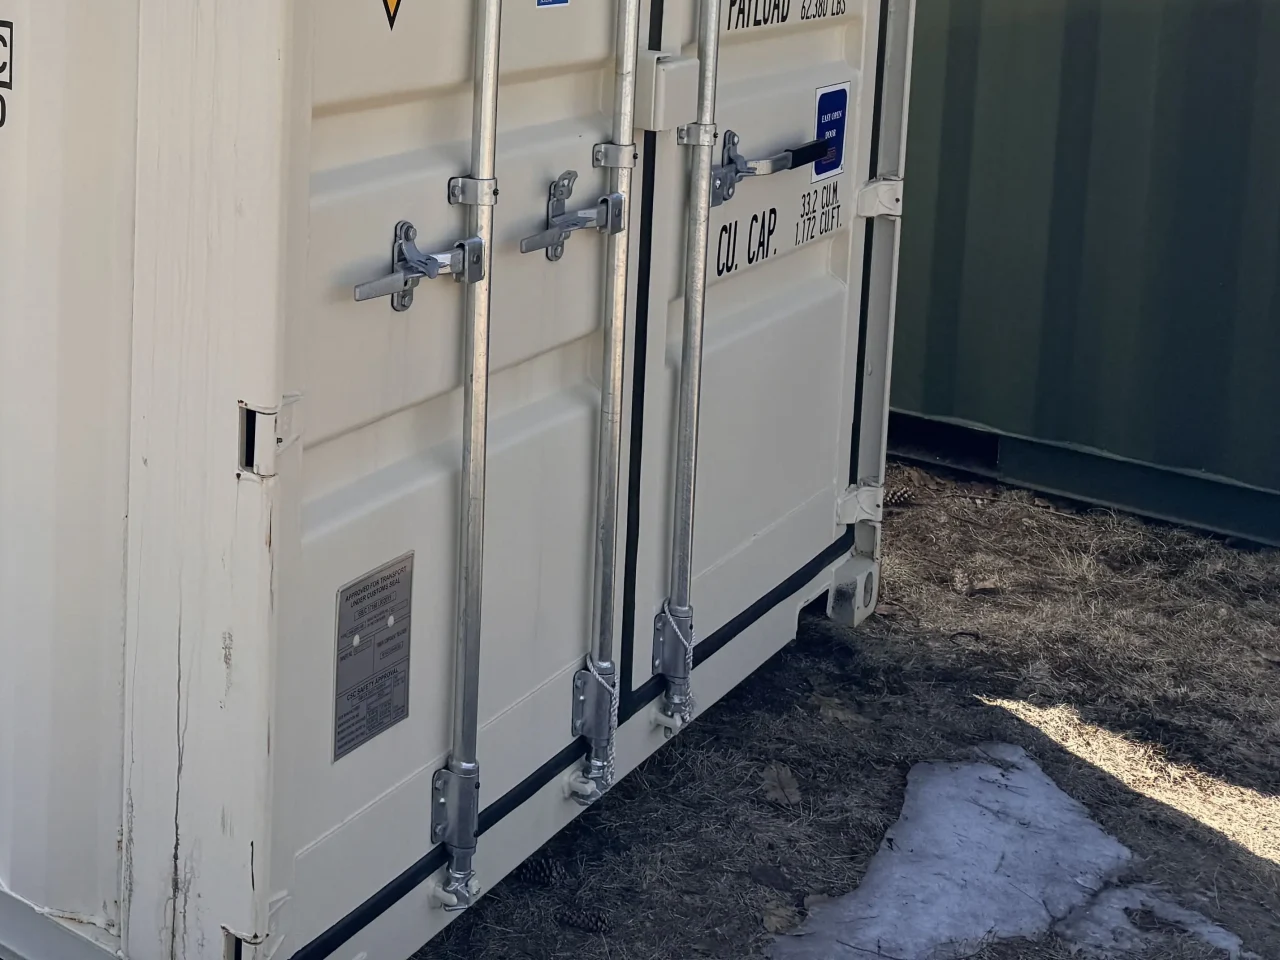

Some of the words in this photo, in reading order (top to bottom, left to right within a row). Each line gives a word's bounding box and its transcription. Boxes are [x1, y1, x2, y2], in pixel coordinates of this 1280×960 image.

[824, 128, 837, 140] DOOR
[800, 189, 818, 219] 33.2
[716, 220, 738, 277] CU.
[747, 207, 777, 265] CAP.
[345, 583, 370, 603] APPROVED
[370, 579, 380, 590] FOR
[380, 565, 407, 584] TRANSPORT
[350, 594, 367, 608] UNDER
[366, 583, 389, 599] CUSTOMS
[388, 577, 401, 588] SEAL
[357, 681, 374, 694] SAFETY
[374, 667, 399, 685] APPROVAL
